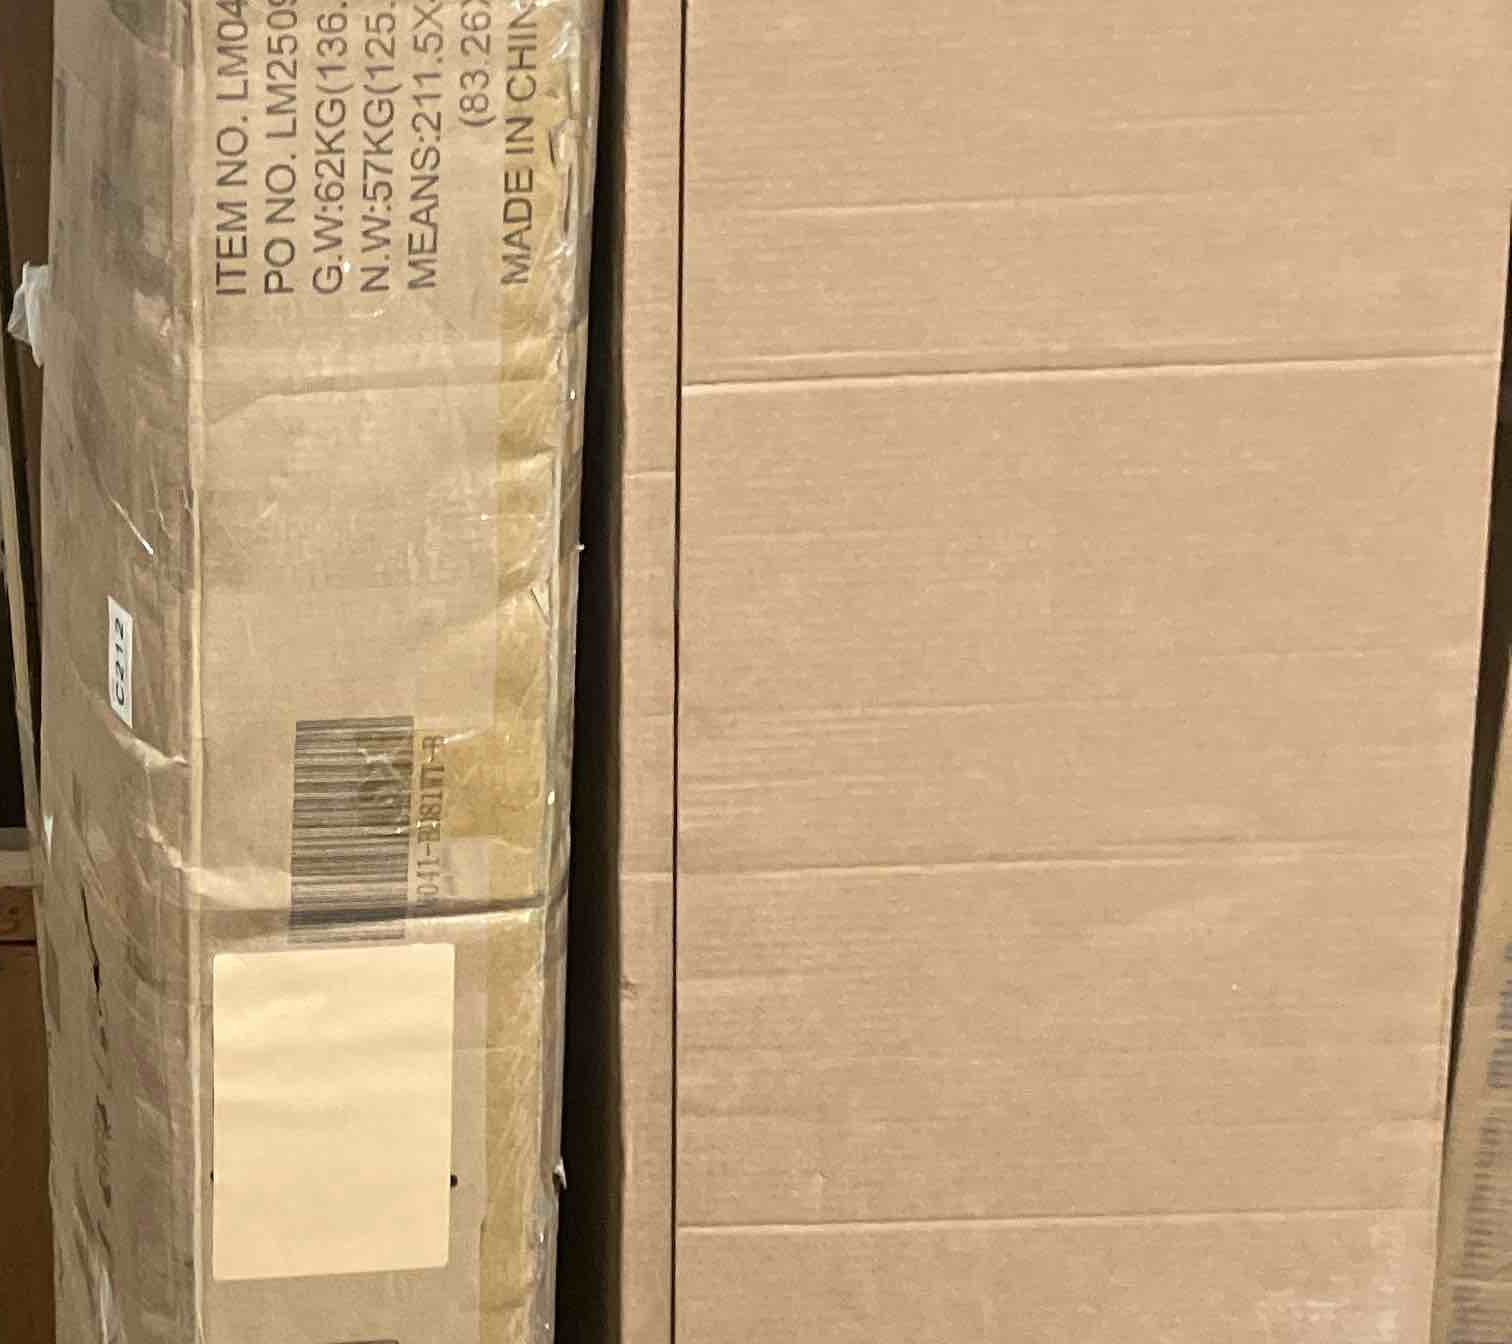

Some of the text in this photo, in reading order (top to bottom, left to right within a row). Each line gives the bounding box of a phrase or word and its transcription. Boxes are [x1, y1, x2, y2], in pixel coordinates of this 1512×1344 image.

[215, 114, 249, 187] NO.
[504, 115, 535, 156] IN
[264, 153, 297, 225] NO.
[215, 200, 248, 296] ITEM
[500, 167, 534, 286] MADE
[263, 237, 296, 295] PO
[114, 617, 126, 706] C212
